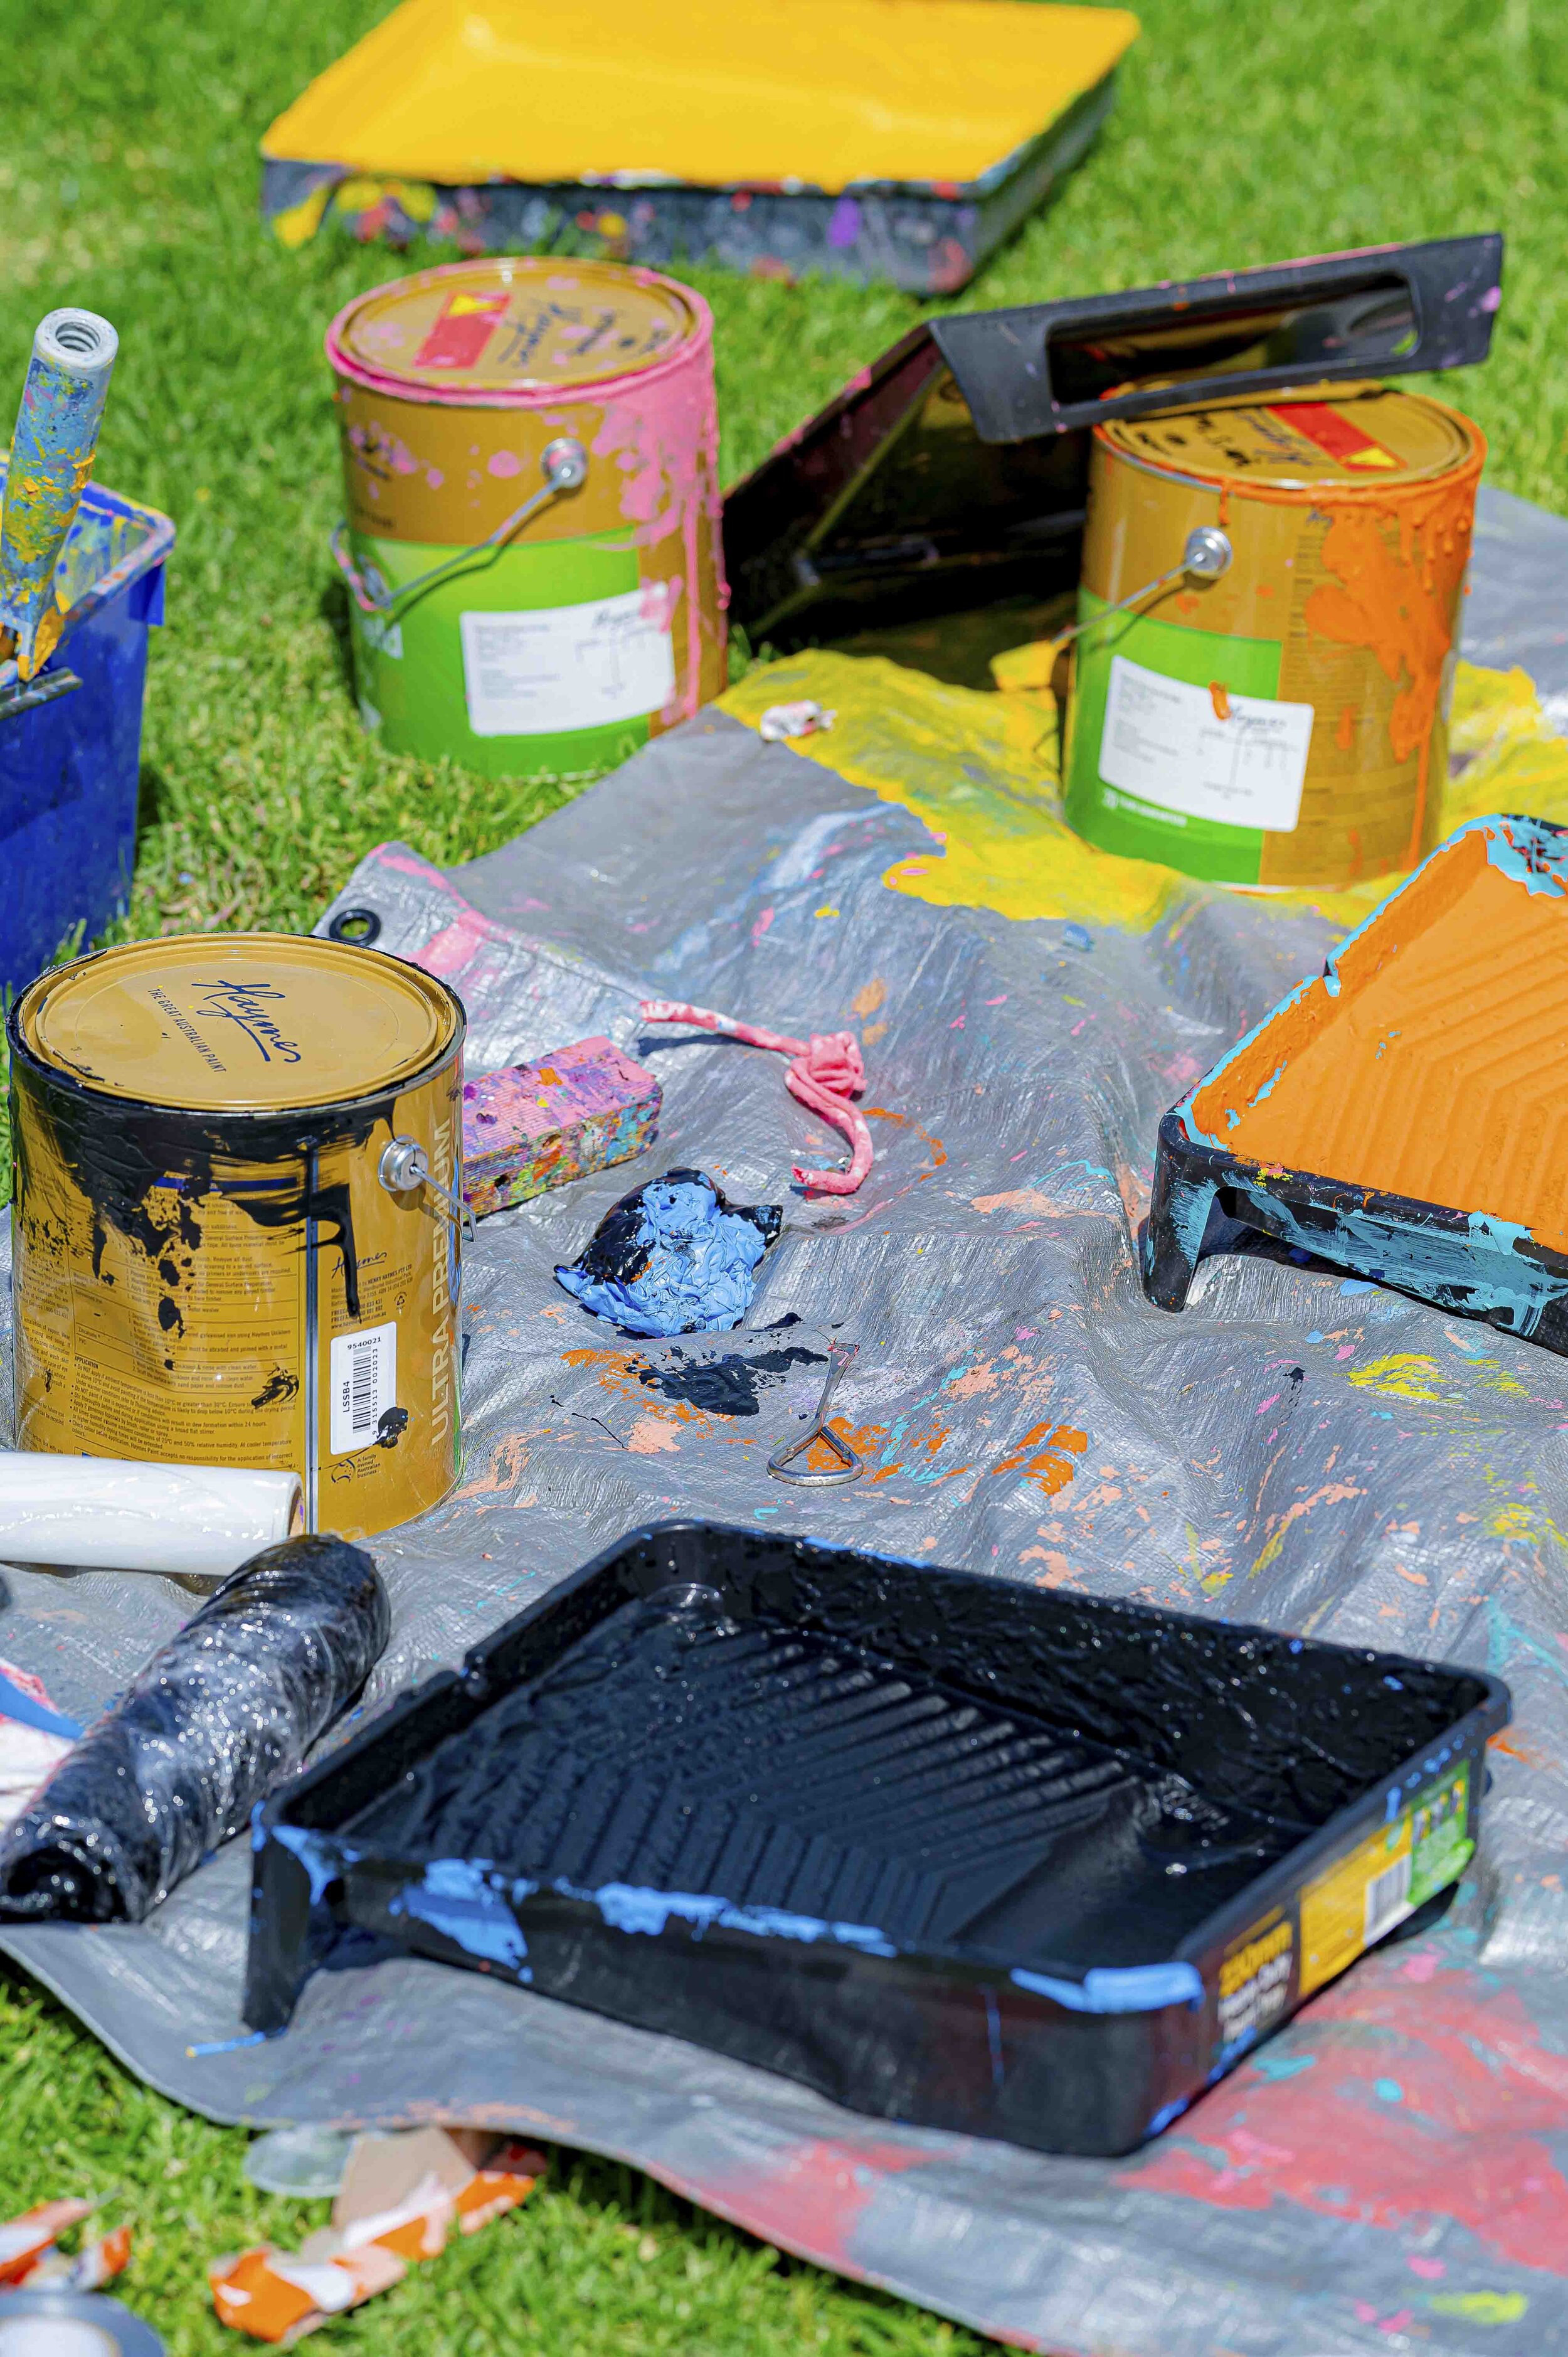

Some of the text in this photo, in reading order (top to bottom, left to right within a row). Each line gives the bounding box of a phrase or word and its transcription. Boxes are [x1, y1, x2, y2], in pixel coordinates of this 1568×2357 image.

[191, 980, 301, 1062] Haymes
[148, 989, 226, 1073] THE GREAT AUSTRALIAN PAINT
[347, 1337, 381, 1350] 9540021
[75, 1355, 98, 1369] APPLICATION
[82, 1366, 91, 1374] NOT
[91, 1371, 100, 1379] apply
[432, 1313, 449, 1445] ULTRA
[76, 1378, 87, 1387] Under
[102, 1389, 120, 1400] conditions
[80, 1386, 88, 1395] NOT
[73, 1399, 83, 1410] Apply
[82, 1395, 101, 1408] thoroughly
[72, 1420, 83, 1429] Check
[147, 1447, 159, 1455] Paint
[159, 1451, 179, 1459] accepts
[186, 1454, 219, 1462] responsibility
[237, 1453, 266, 1462] application
[358, 1459, 374, 1468] owned
[362, 1454, 377, 1463] family
[358, 1462, 381, 1473] Australian
[358, 1469, 377, 1479] business
